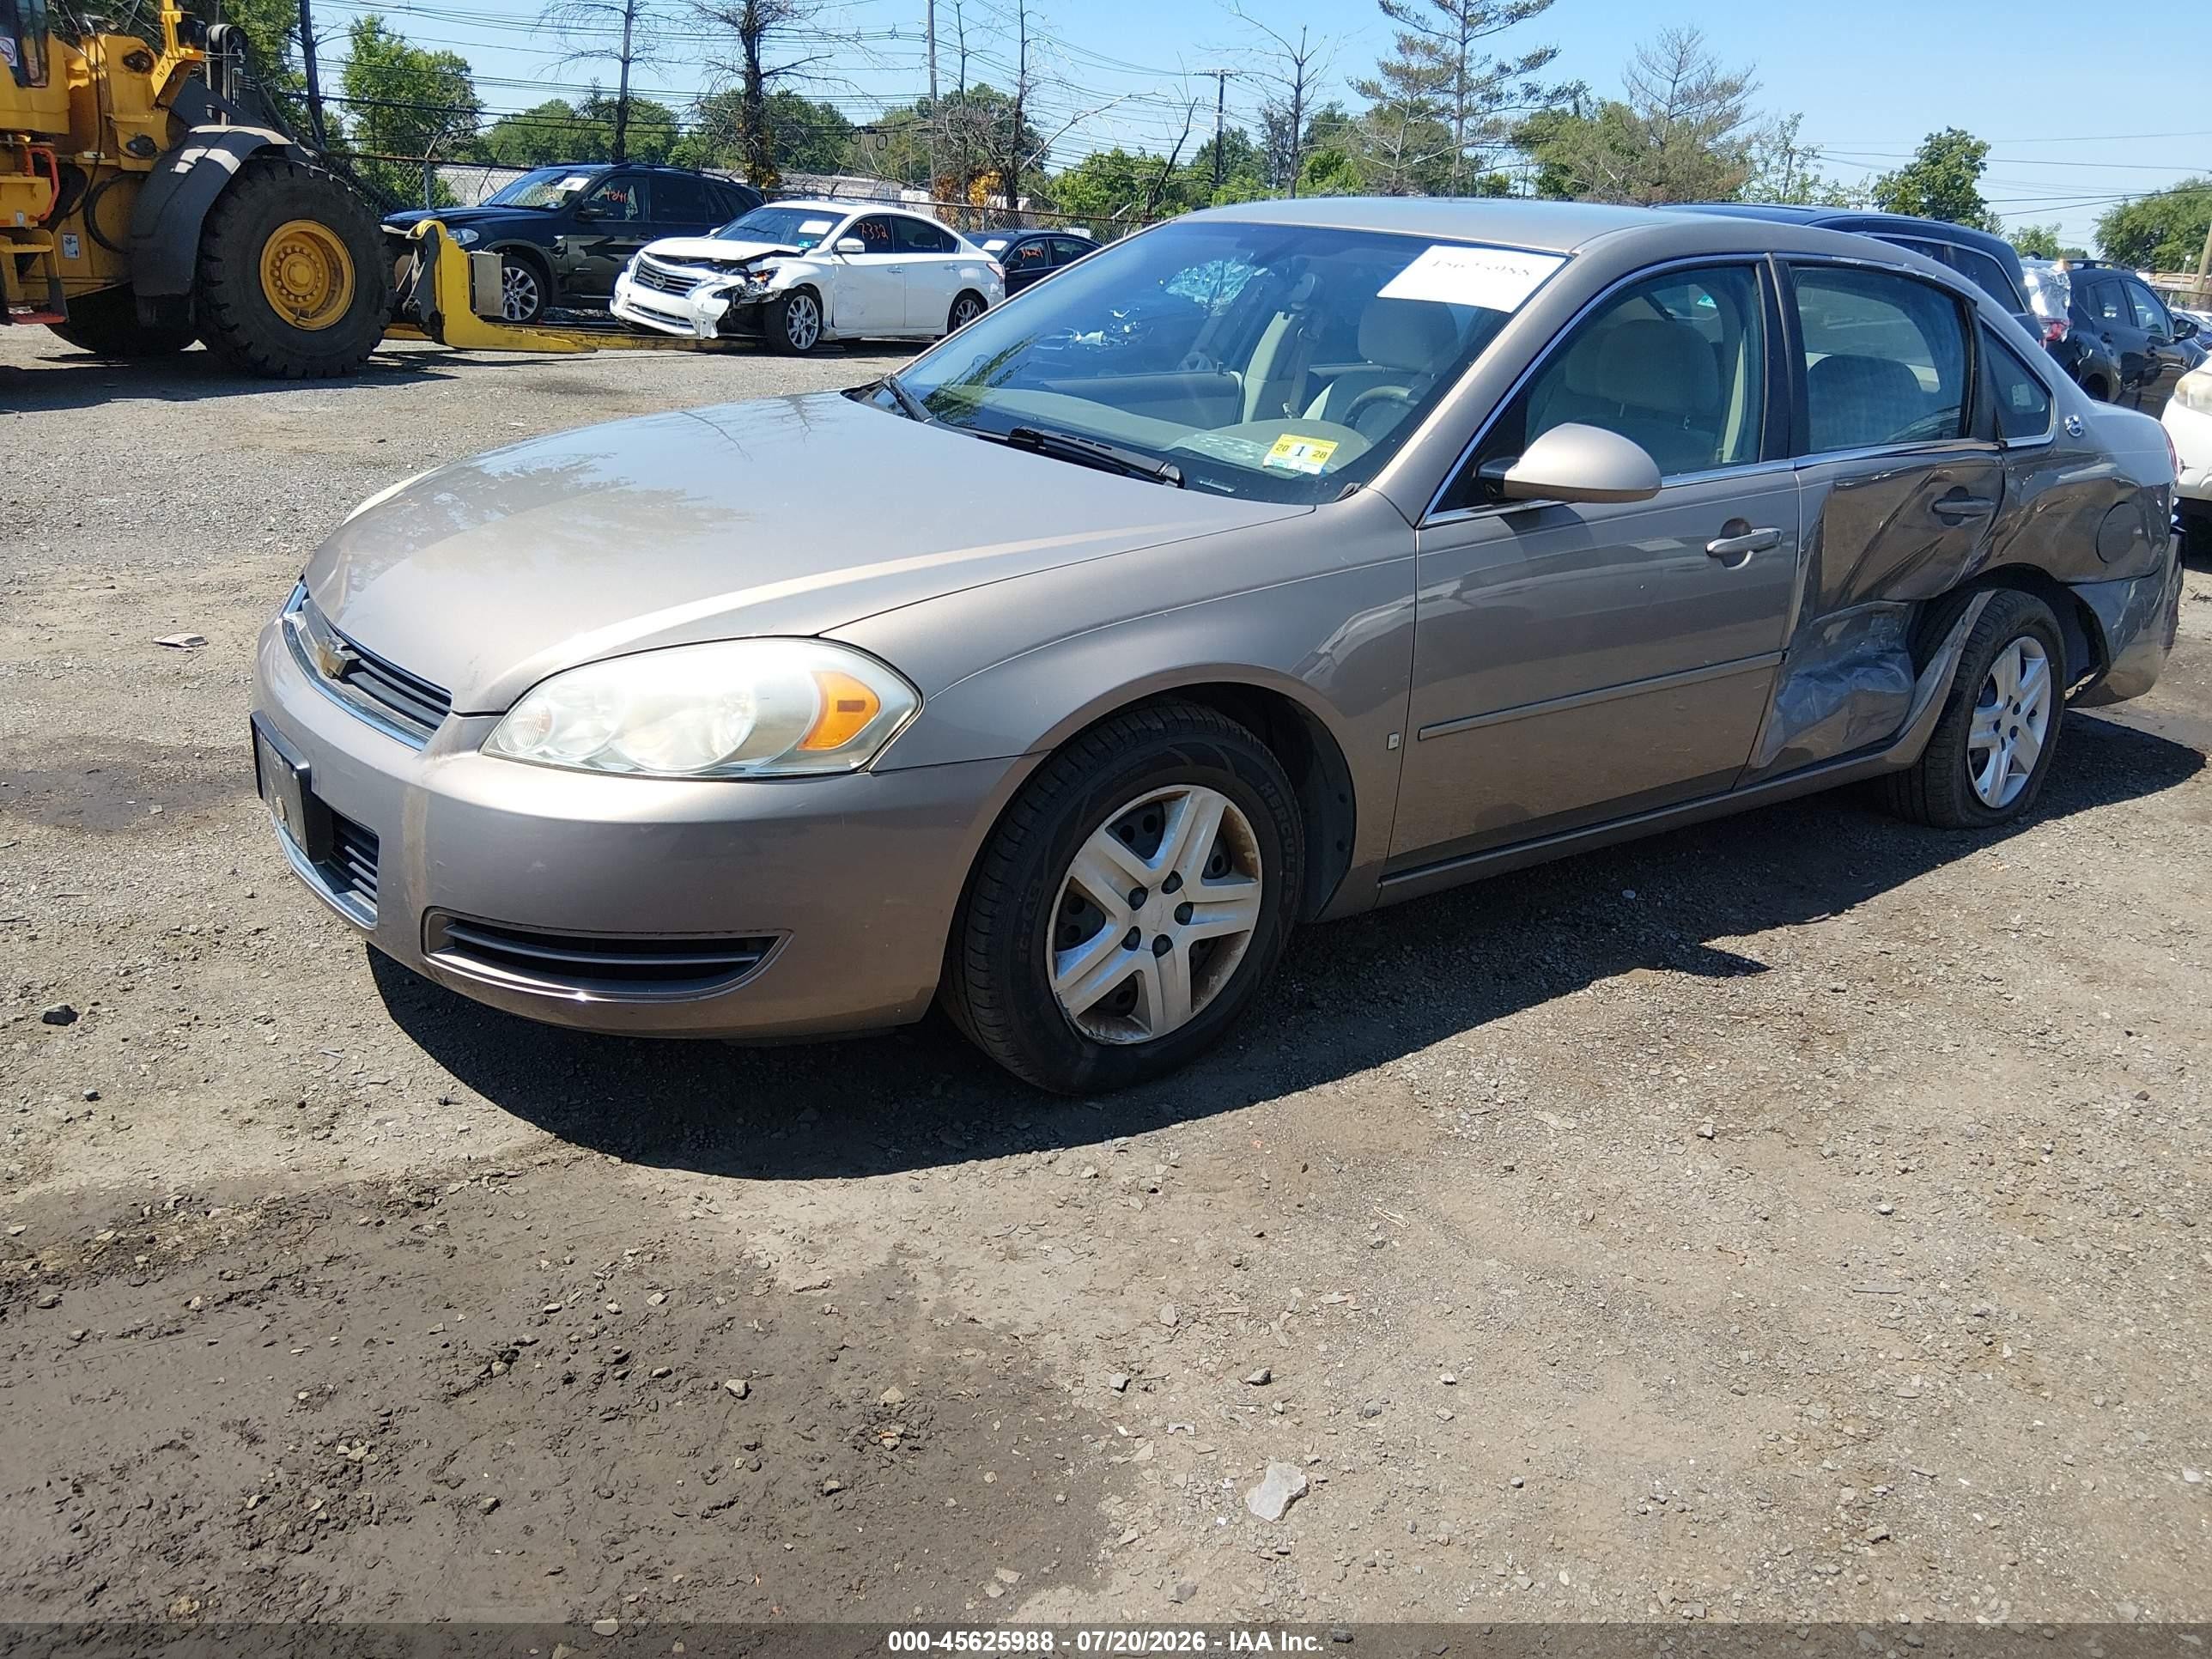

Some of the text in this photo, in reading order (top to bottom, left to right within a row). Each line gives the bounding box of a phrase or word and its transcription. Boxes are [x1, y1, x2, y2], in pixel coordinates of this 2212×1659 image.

[1276, 443, 1290, 453] 20
[1295, 446, 1305, 457] 1
[1260, 781, 1296, 902] HERCULES
